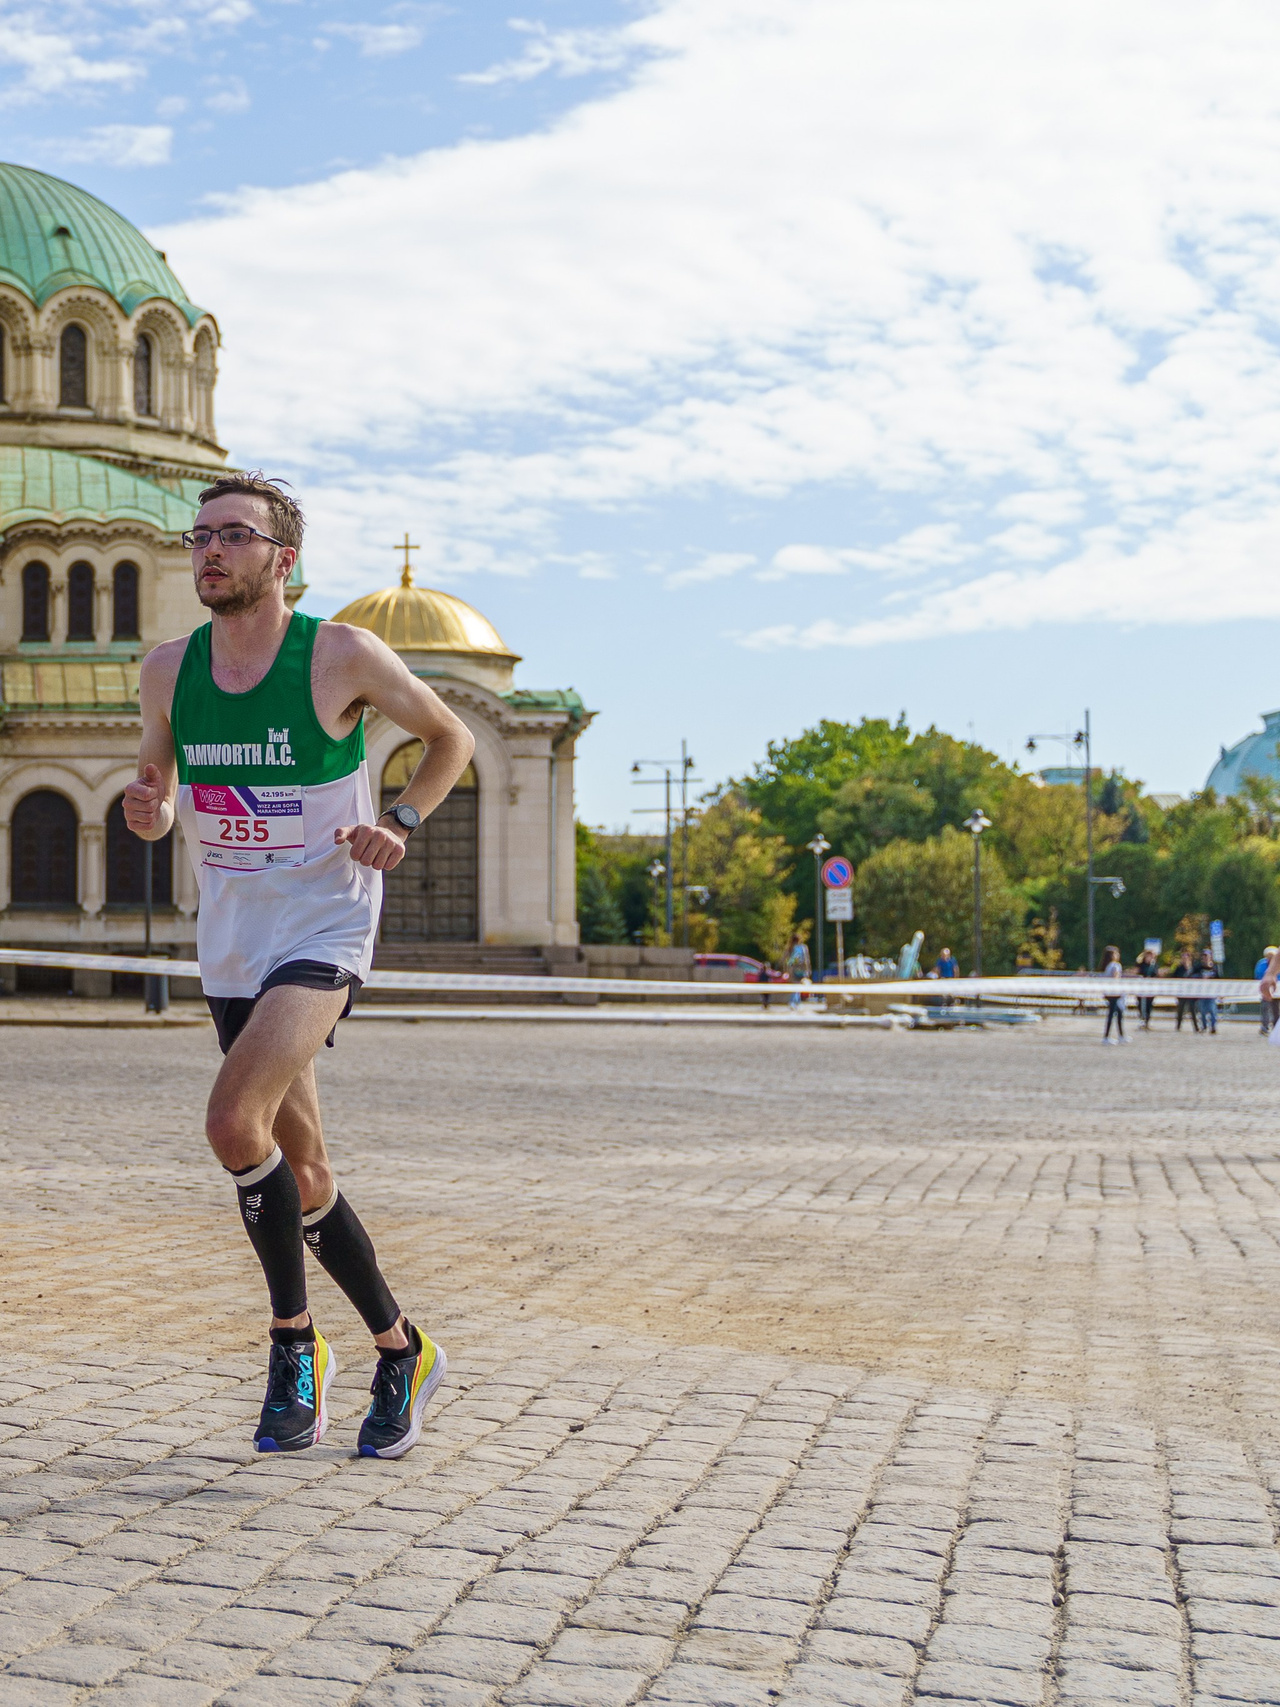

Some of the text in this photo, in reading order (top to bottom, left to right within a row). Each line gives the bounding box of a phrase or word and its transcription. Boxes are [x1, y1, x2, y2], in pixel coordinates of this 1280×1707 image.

[182, 743, 296, 766] TAMWORTH A.C.
[218, 818, 269, 842] 255
[297, 1354, 314, 1410] HOKA
